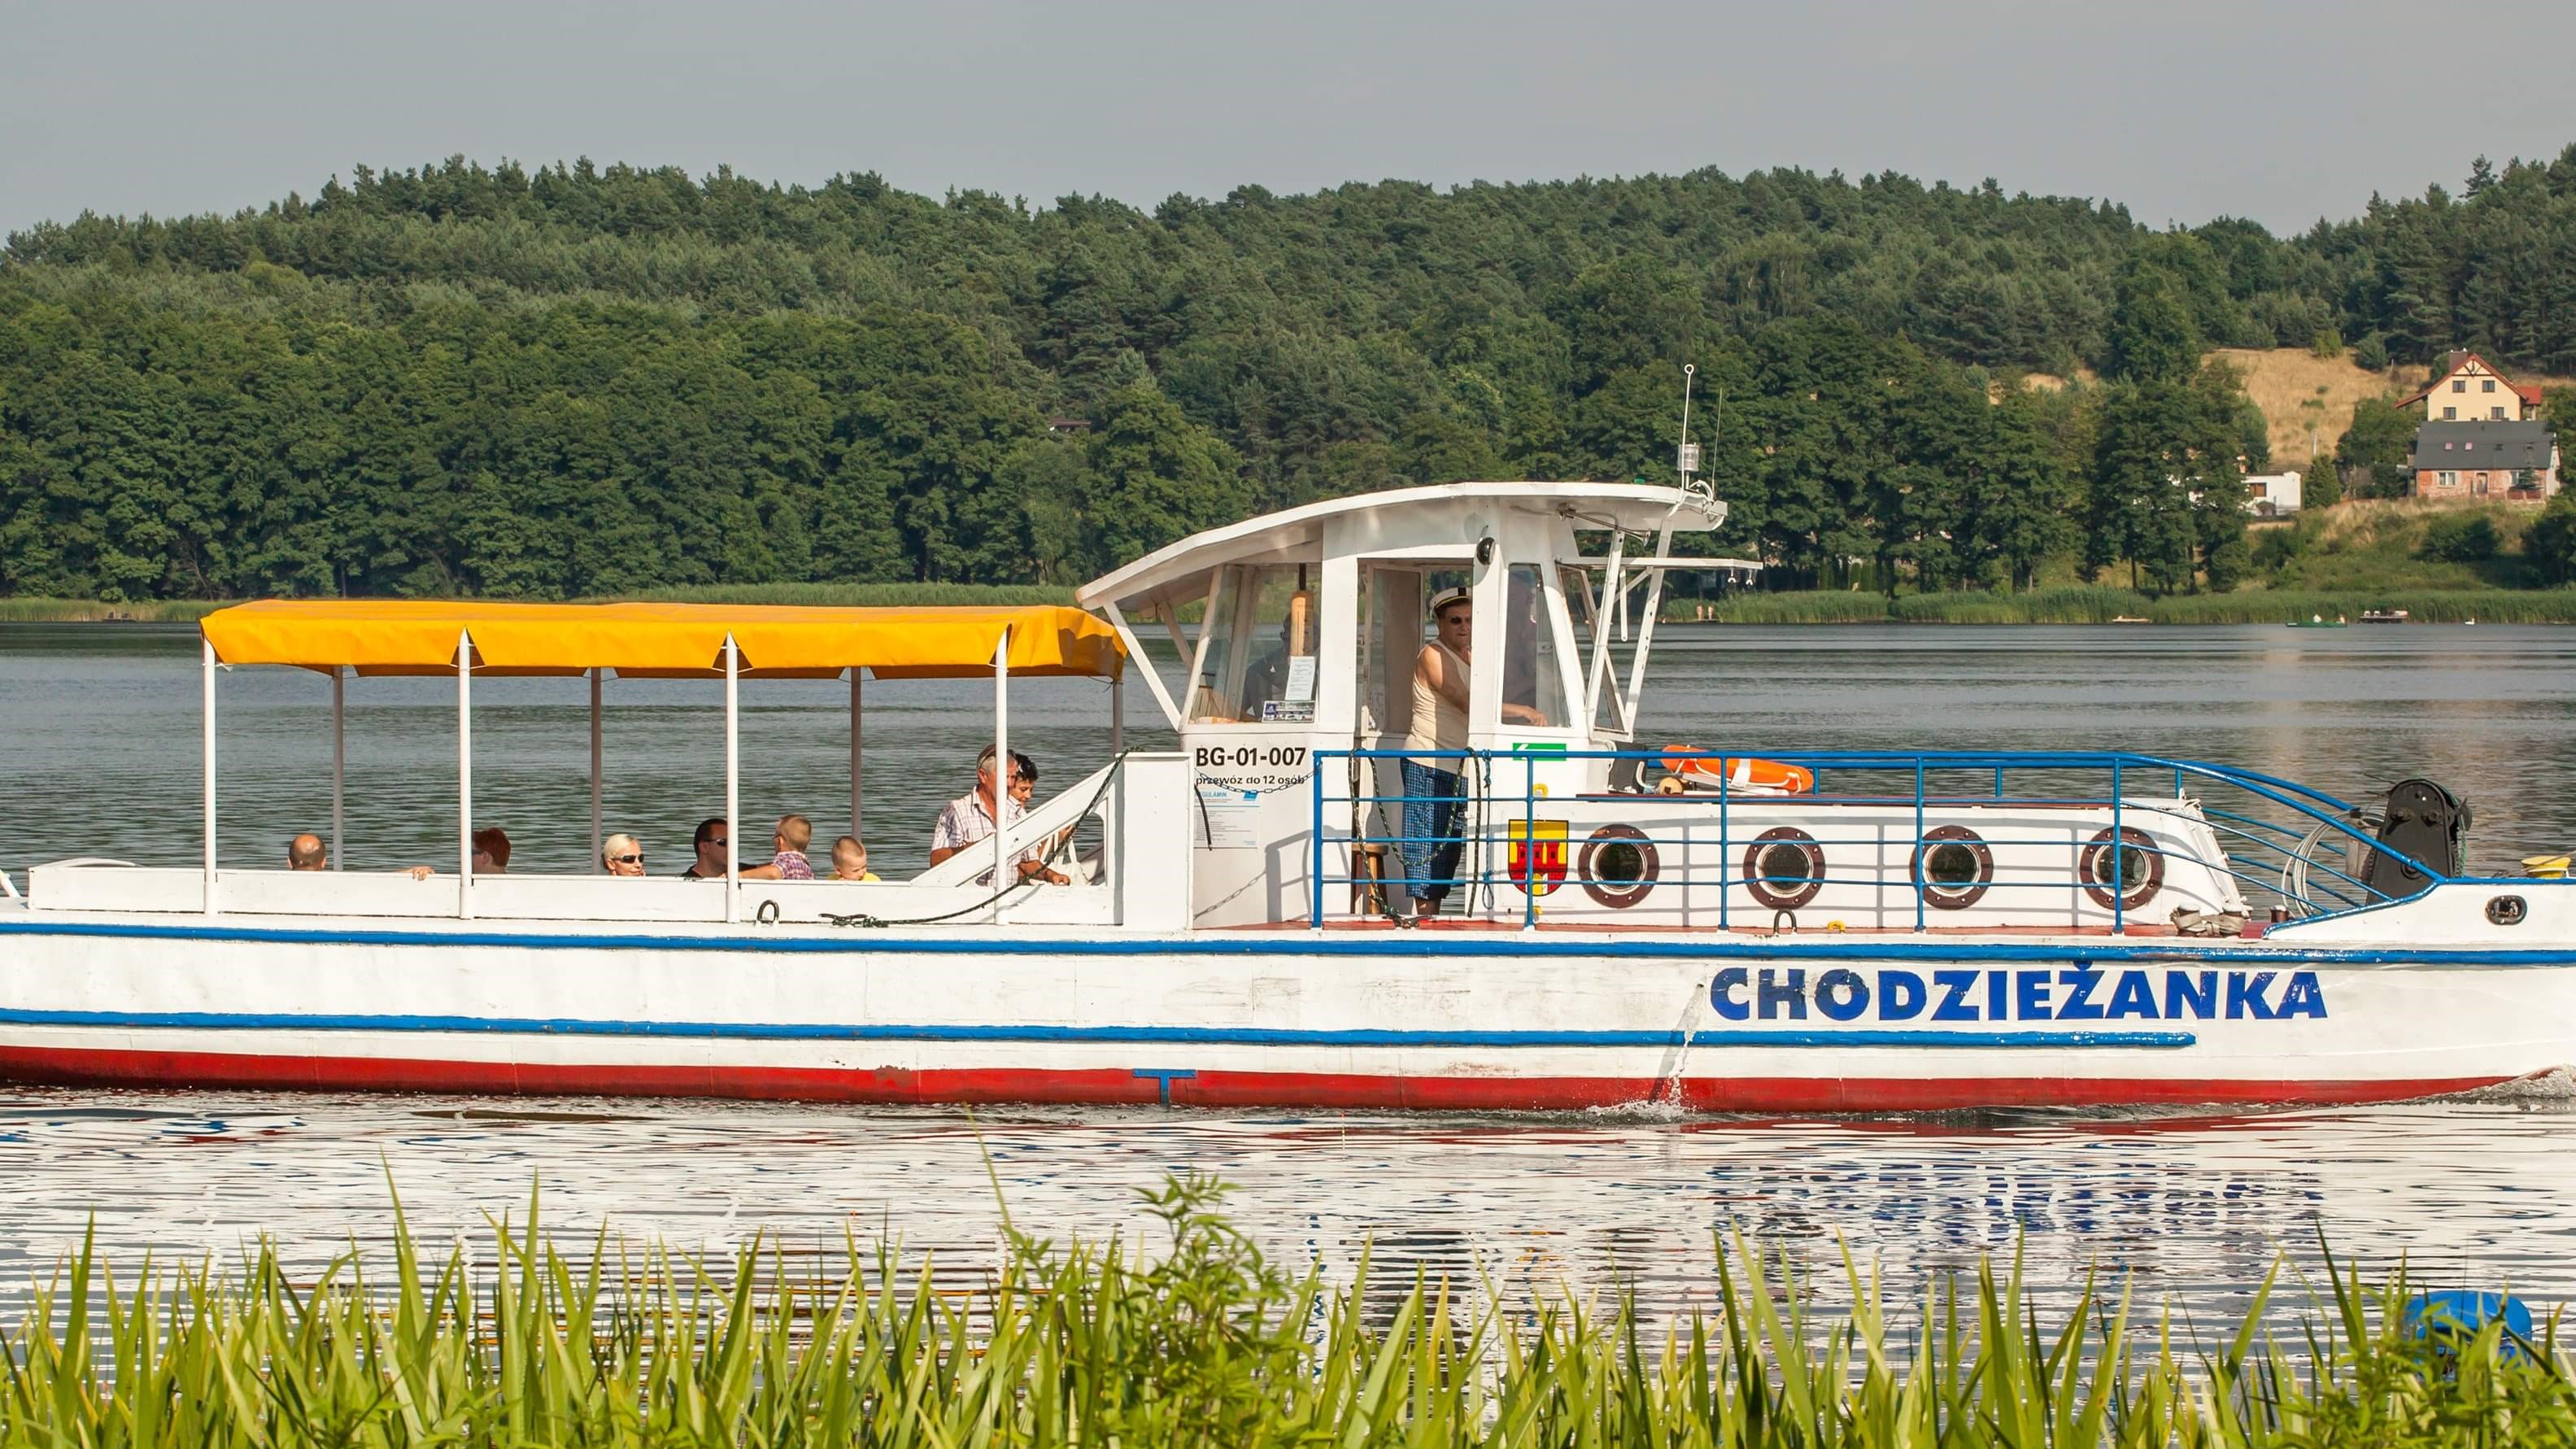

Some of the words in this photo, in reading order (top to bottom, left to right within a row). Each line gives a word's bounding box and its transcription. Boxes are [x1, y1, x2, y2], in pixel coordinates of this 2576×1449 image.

[1196, 747, 1306, 766] BG-01-007
[1196, 775, 1243, 787] przewóz
[1246, 775, 1261, 785] do
[1262, 775, 1275, 785] 12
[1711, 960, 2328, 1021] CHODZIEŻANKA
